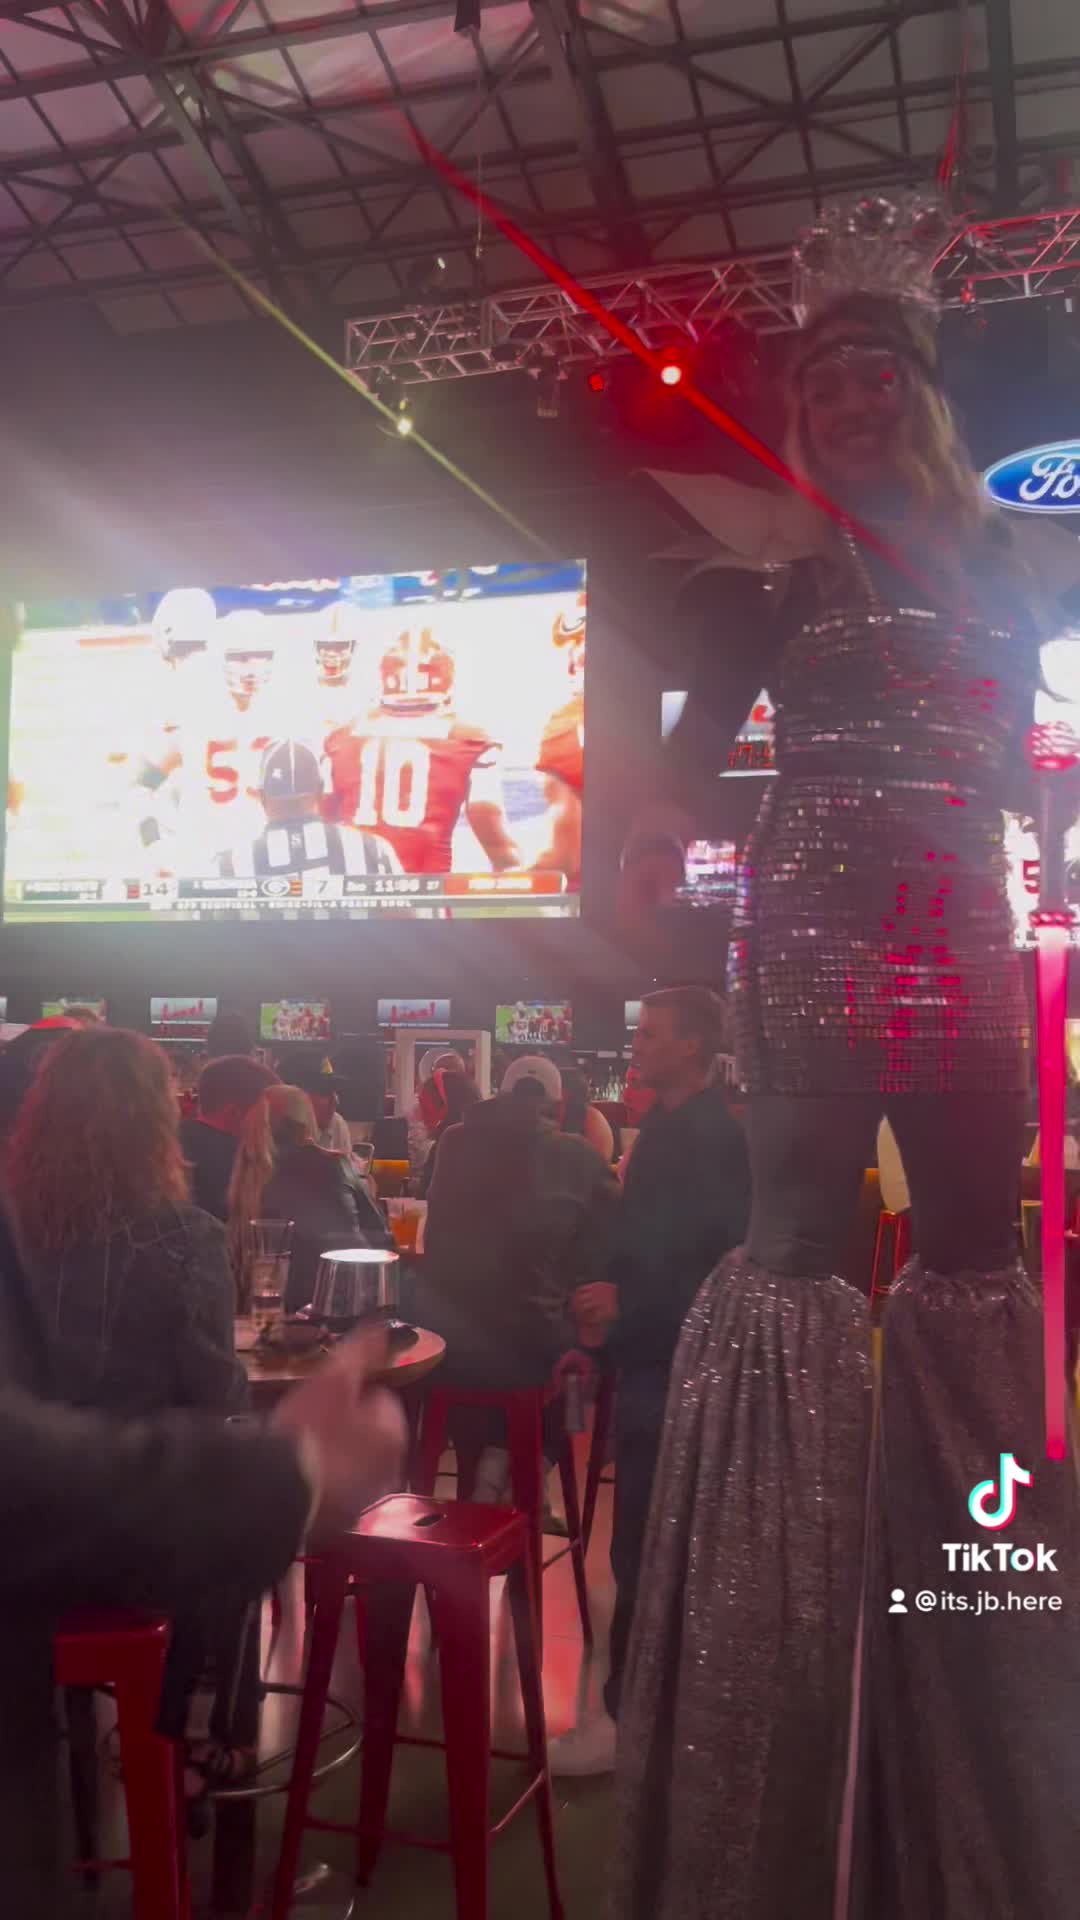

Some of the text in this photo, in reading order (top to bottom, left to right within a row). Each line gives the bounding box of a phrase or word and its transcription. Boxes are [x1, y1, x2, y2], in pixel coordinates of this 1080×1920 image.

[352, 735, 432, 829] 10
[143, 882, 168, 896] 14
[318, 880, 329, 894] 7
